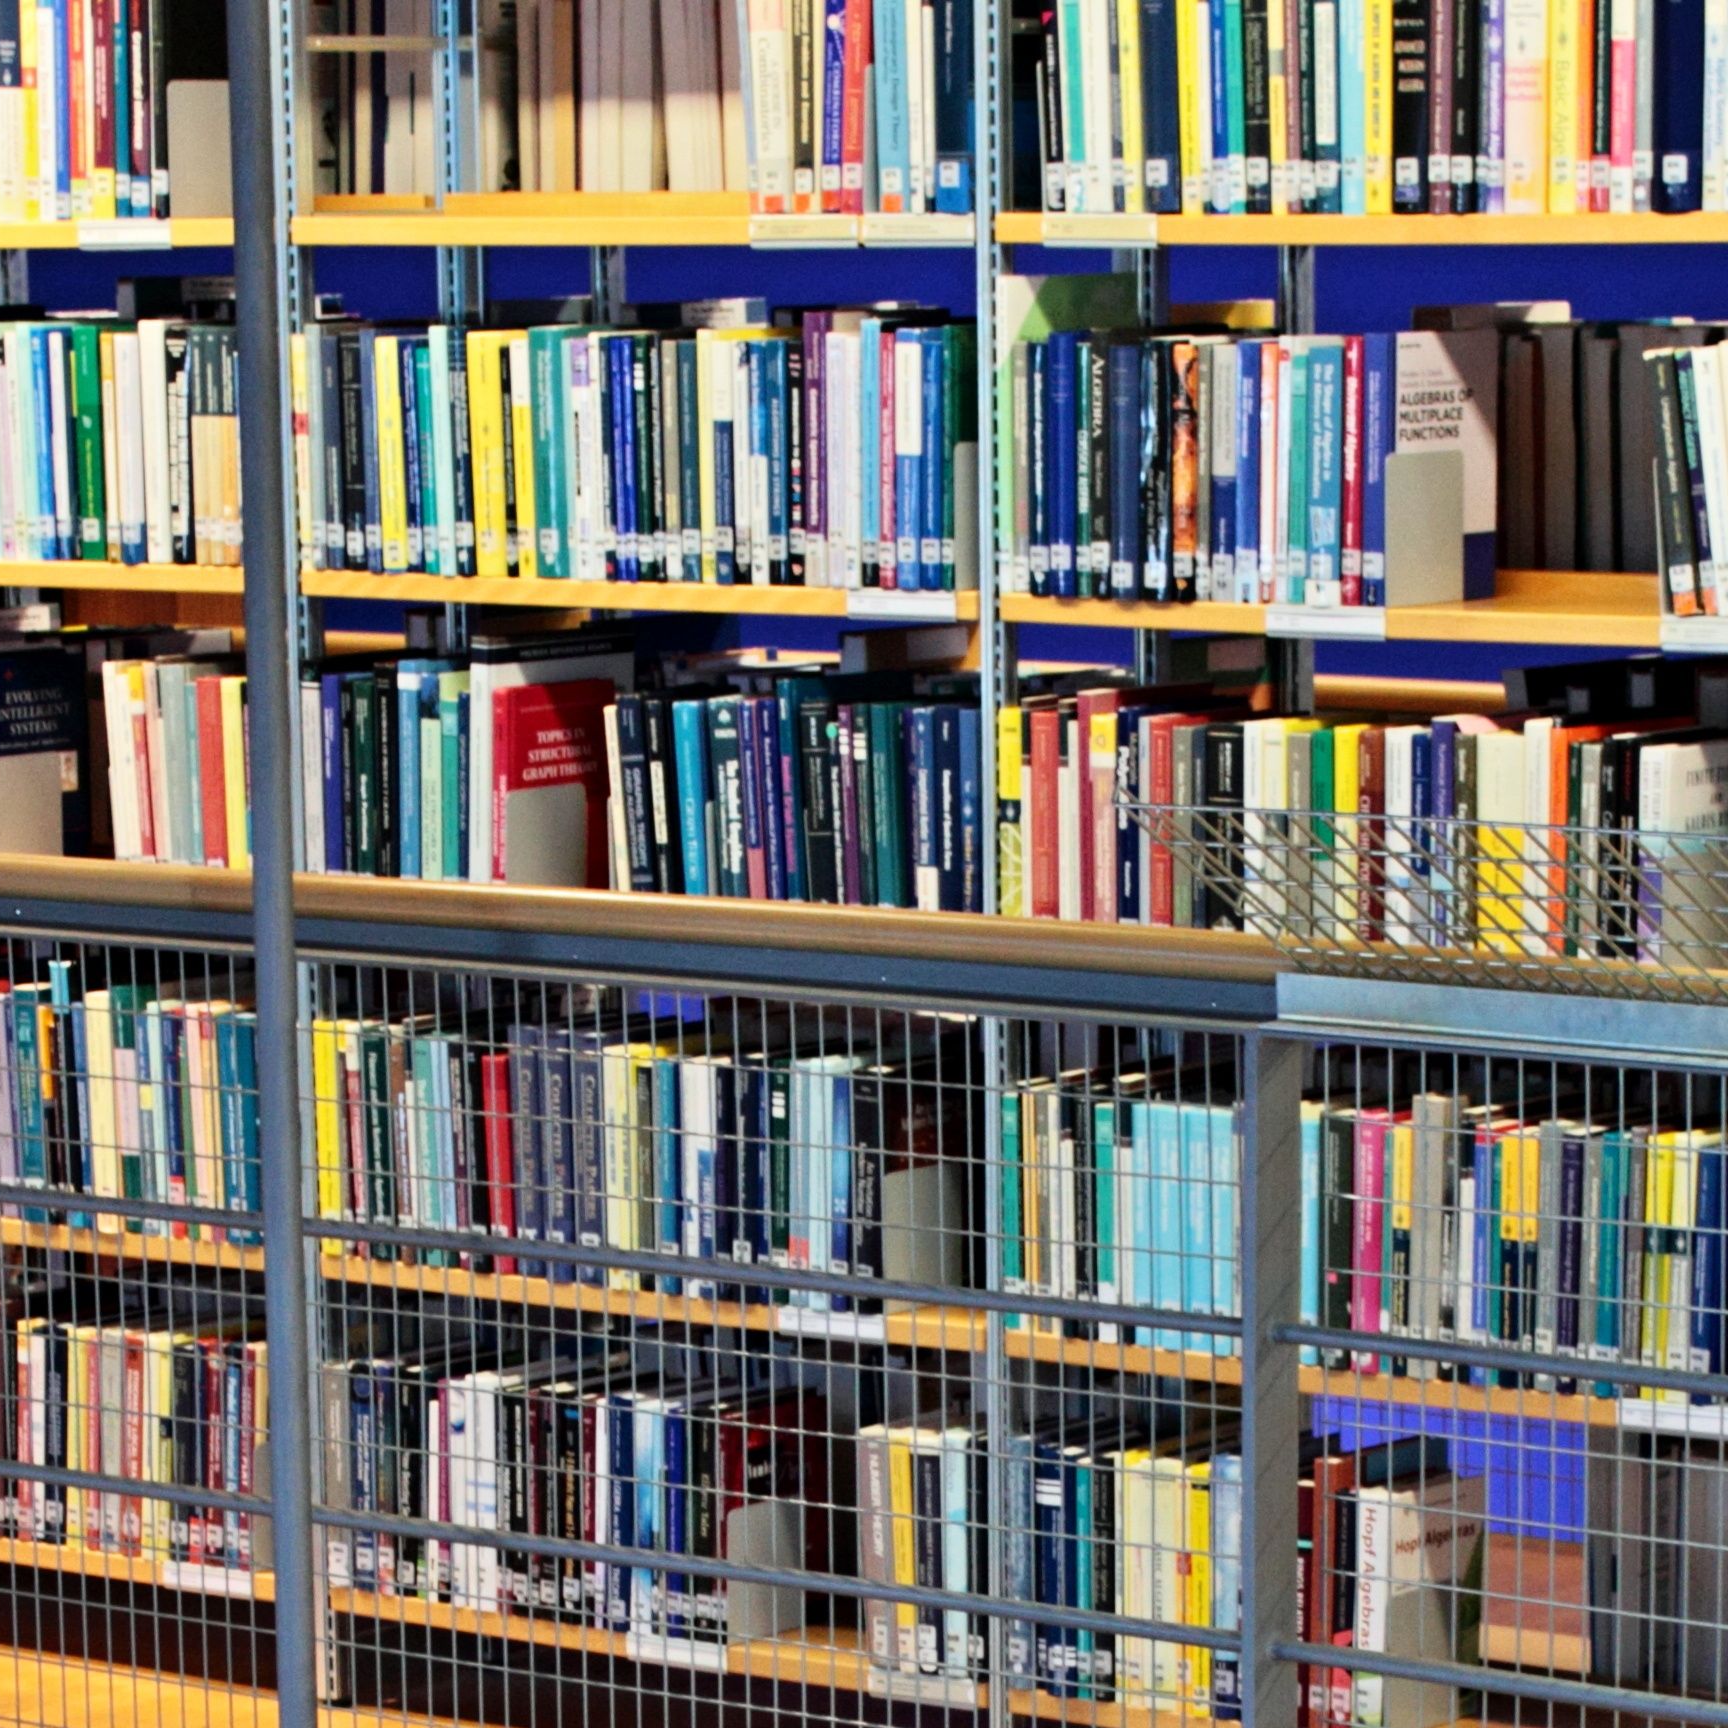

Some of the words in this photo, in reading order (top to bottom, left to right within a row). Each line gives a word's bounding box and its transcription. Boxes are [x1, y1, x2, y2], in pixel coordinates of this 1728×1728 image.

[1093, 353, 1107, 438] ALGEBRA
[1399, 388, 1455, 406] ALGEBRAS
[1457, 387, 1473, 402] OF
[1398, 406, 1465, 423] MULTIPLACE
[1398, 425, 1461, 442] FUNCTIONS
[6, 687, 63, 705] EVOLVING
[10, 719, 59, 736] SYSTEMS
[537, 729, 572, 744] TOPICS
[573, 727, 586, 739] IN
[527, 744, 592, 764] STRUCTURAL
[522, 764, 558, 781] GRAPH
[558, 761, 598, 778] THEORY
[1362, 1507, 1378, 1558] Hopf
[1424, 1523, 1476, 1549] Algeras
[1358, 1562, 1376, 1648] Agebras
